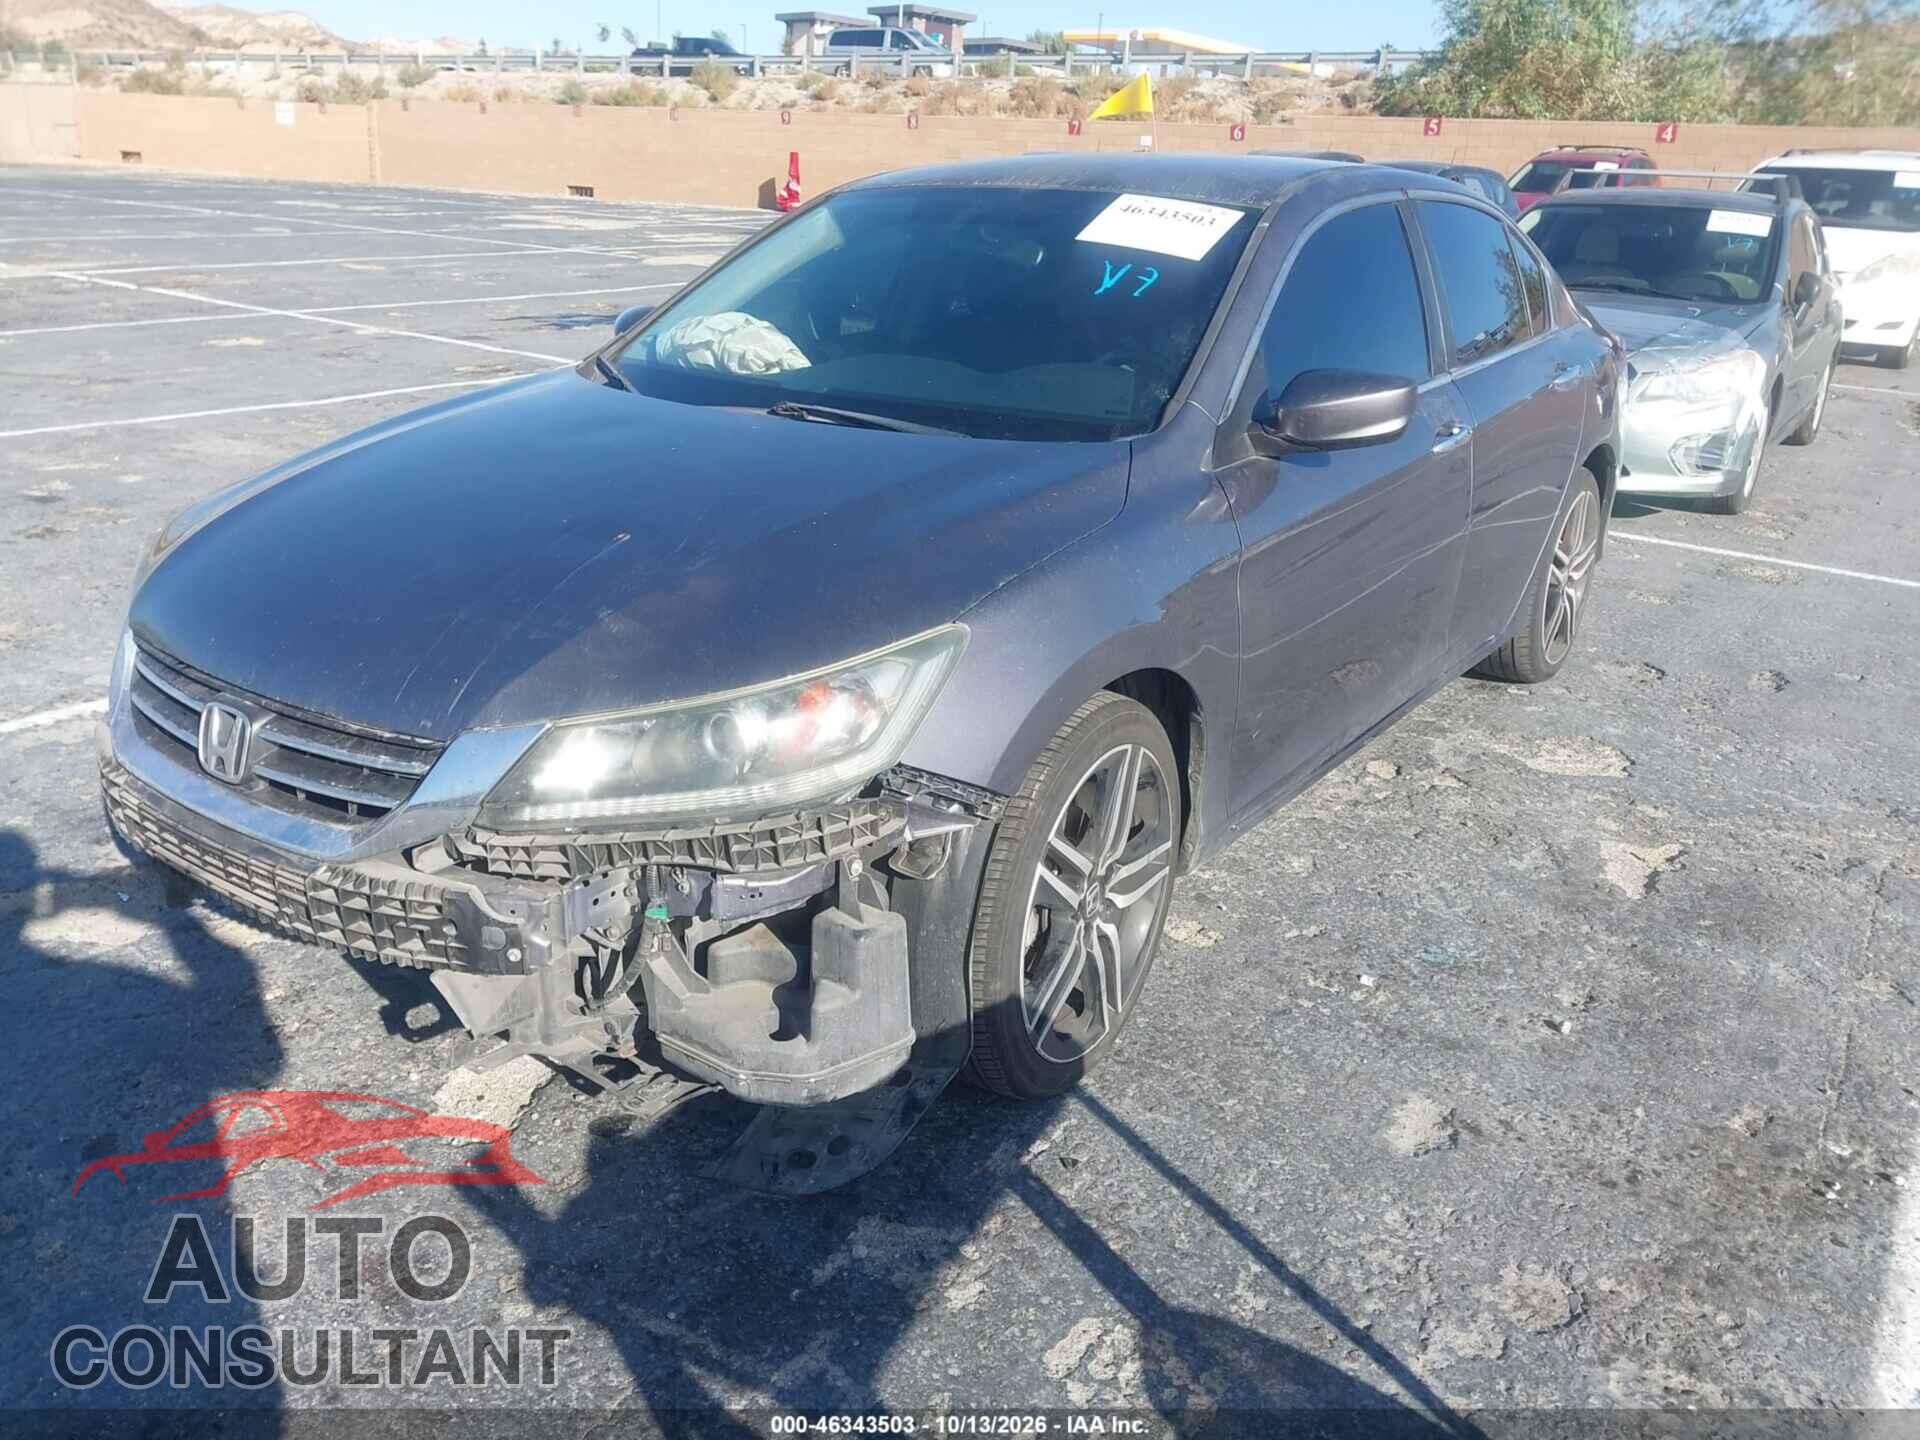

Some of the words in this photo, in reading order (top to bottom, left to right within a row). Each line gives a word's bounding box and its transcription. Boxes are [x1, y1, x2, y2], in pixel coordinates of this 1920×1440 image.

[1232, 126, 1243, 141] 6
[1427, 119, 1439, 135] 5
[1660, 124, 1673, 143] 4
